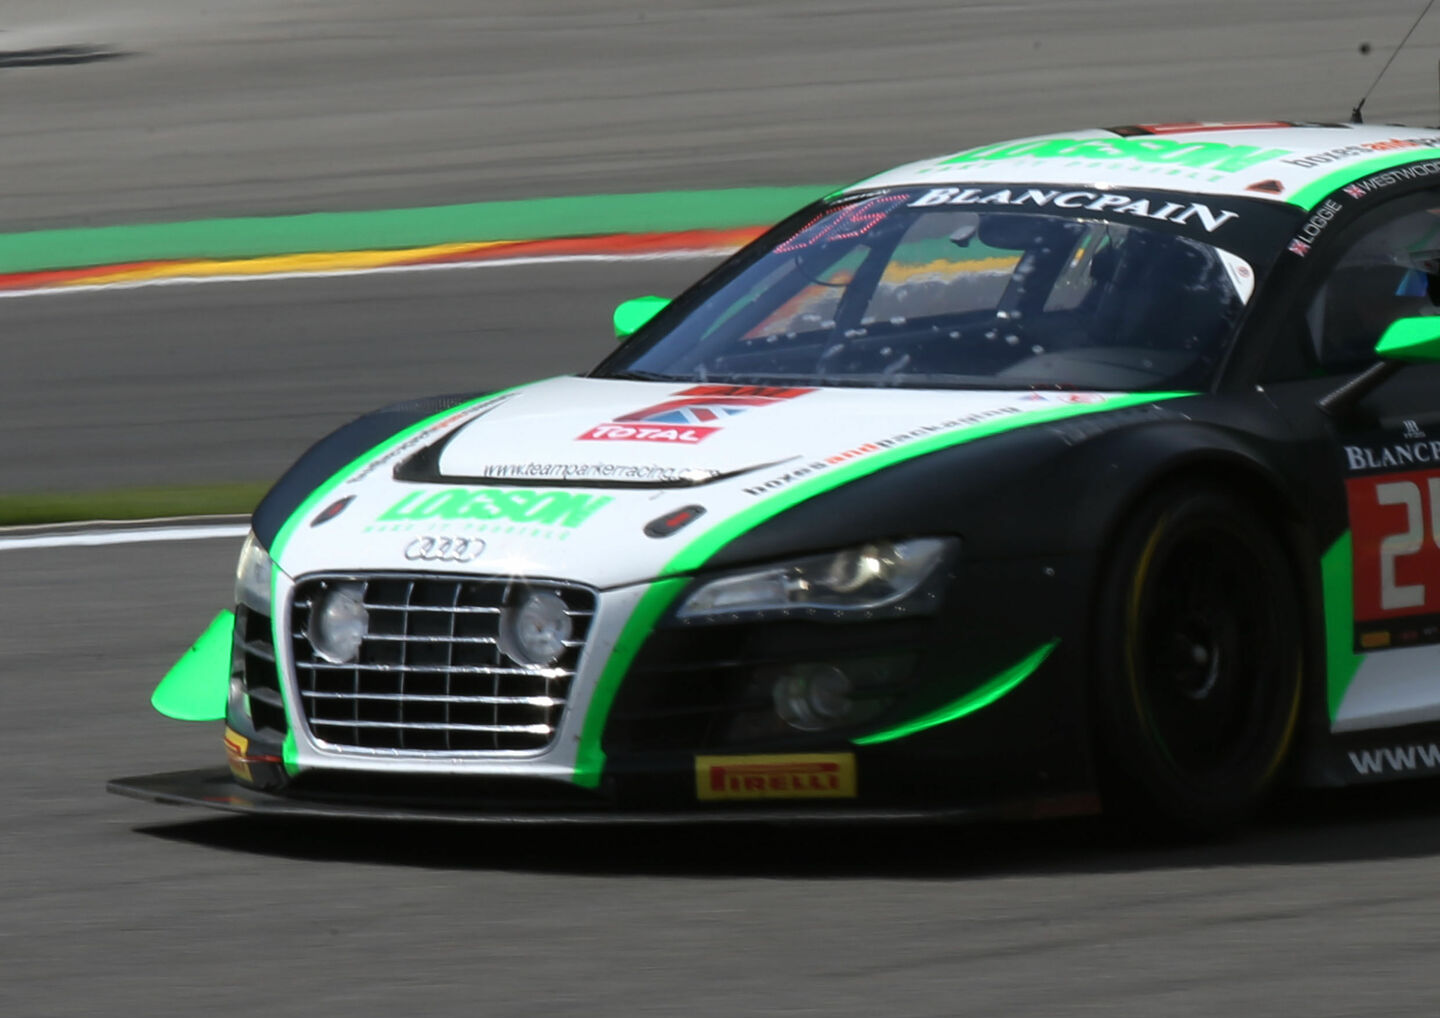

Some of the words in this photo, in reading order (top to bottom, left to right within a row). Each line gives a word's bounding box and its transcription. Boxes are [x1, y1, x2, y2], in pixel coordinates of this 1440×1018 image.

[906, 187, 1239, 234] BLANCPAIN
[1302, 199, 1343, 244] LOGGIE
[591, 425, 701, 442] TOTAL
[376, 488, 617, 529] LOGSON
[709, 762, 840, 792] PIRELLI
